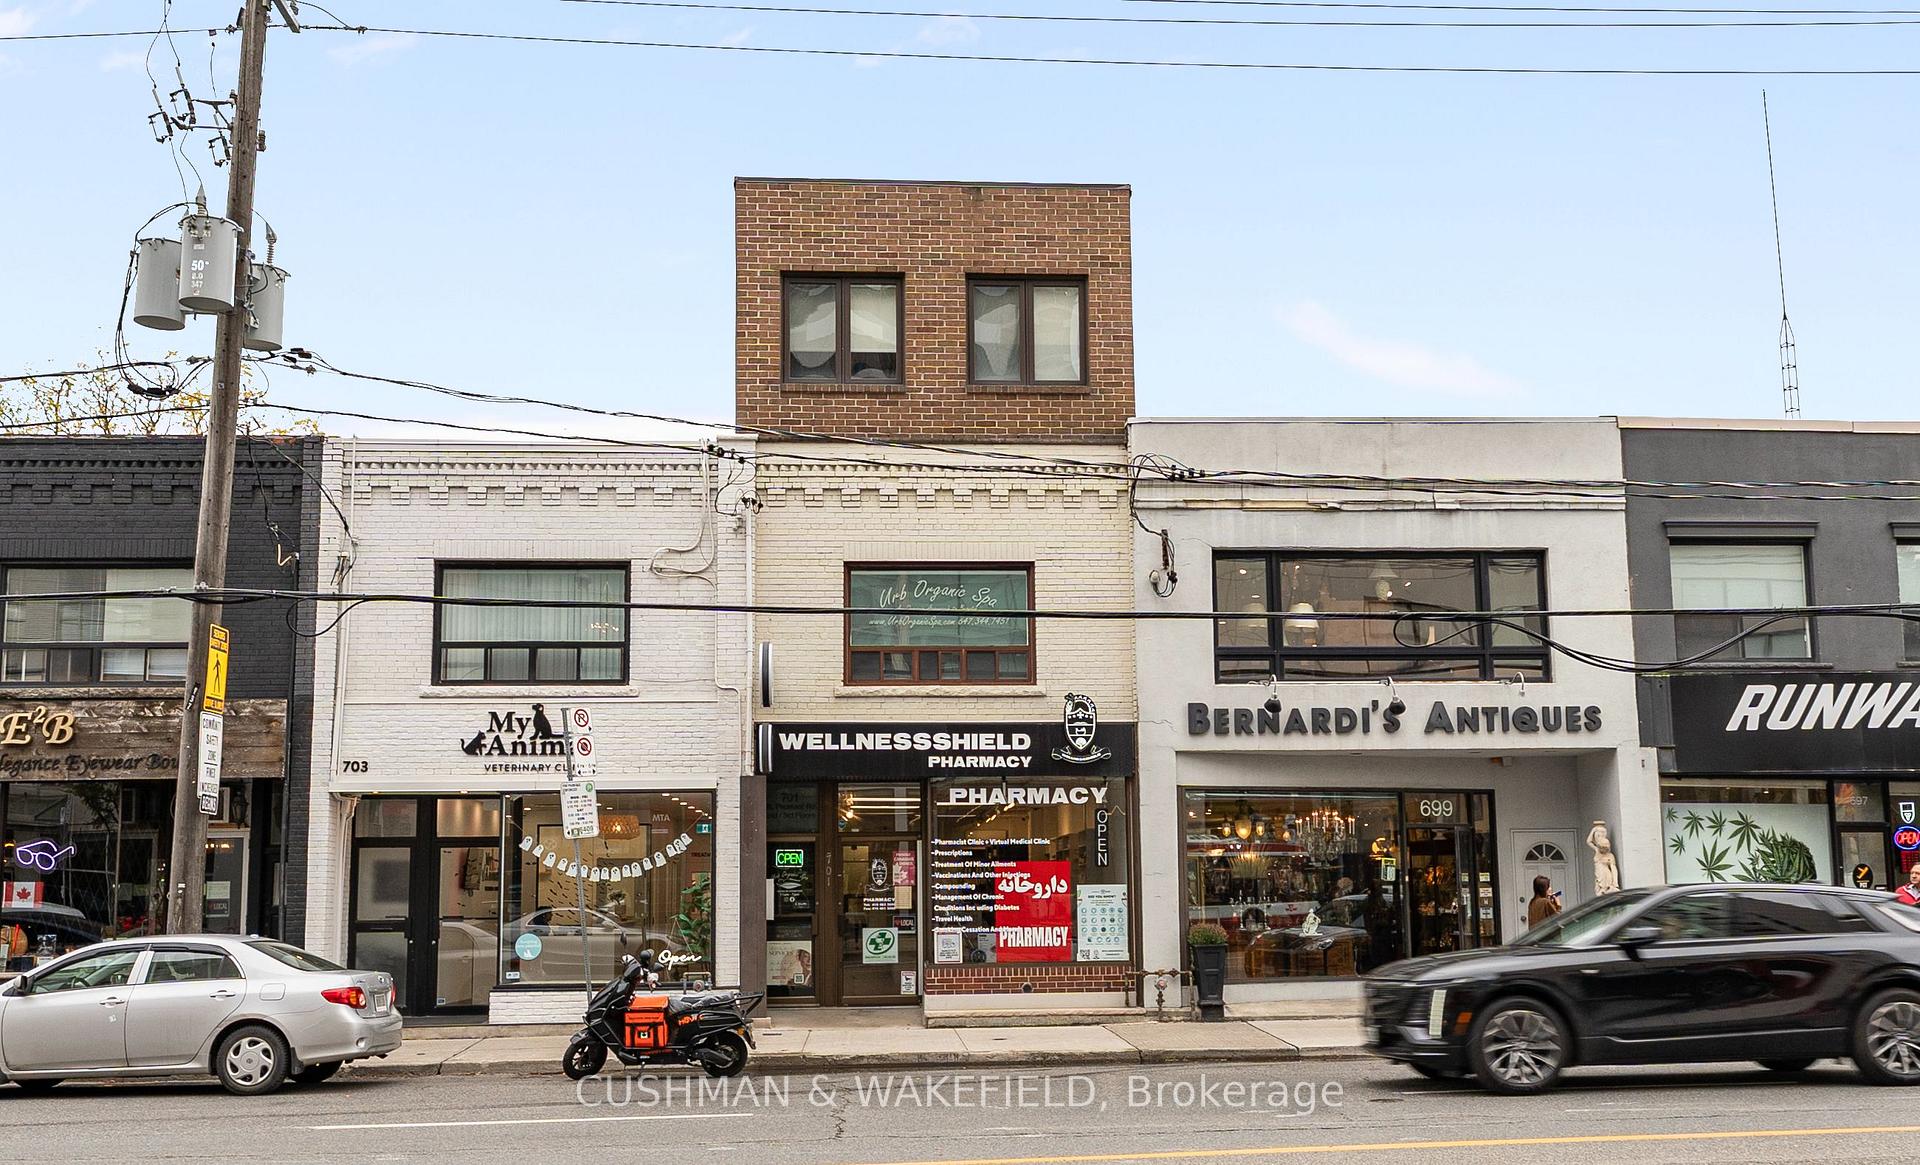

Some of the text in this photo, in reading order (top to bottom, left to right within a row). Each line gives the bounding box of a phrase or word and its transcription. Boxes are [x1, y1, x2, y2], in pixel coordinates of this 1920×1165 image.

[880, 579, 998, 608] Urb Organic Spa
[486, 711, 532, 739] My
[1187, 699, 1602, 736] BERNARDI'S ANTIQUES
[485, 734, 574, 756] Anim
[779, 732, 1031, 751] WELLNESSSHIELD
[66, 753, 144, 775] Eyewear
[342, 761, 368, 773] 703
[484, 763, 551, 772] VETERINARY
[928, 755, 1032, 768] PHARMACY
[950, 787, 1108, 804] PHARMACY
[1420, 800, 1453, 818] 699
[1097, 810, 1108, 866] OPEN
[1897, 831, 1920, 845] OPEN
[999, 926, 1068, 948] PHARMACY
[657, 949, 702, 971] Open
